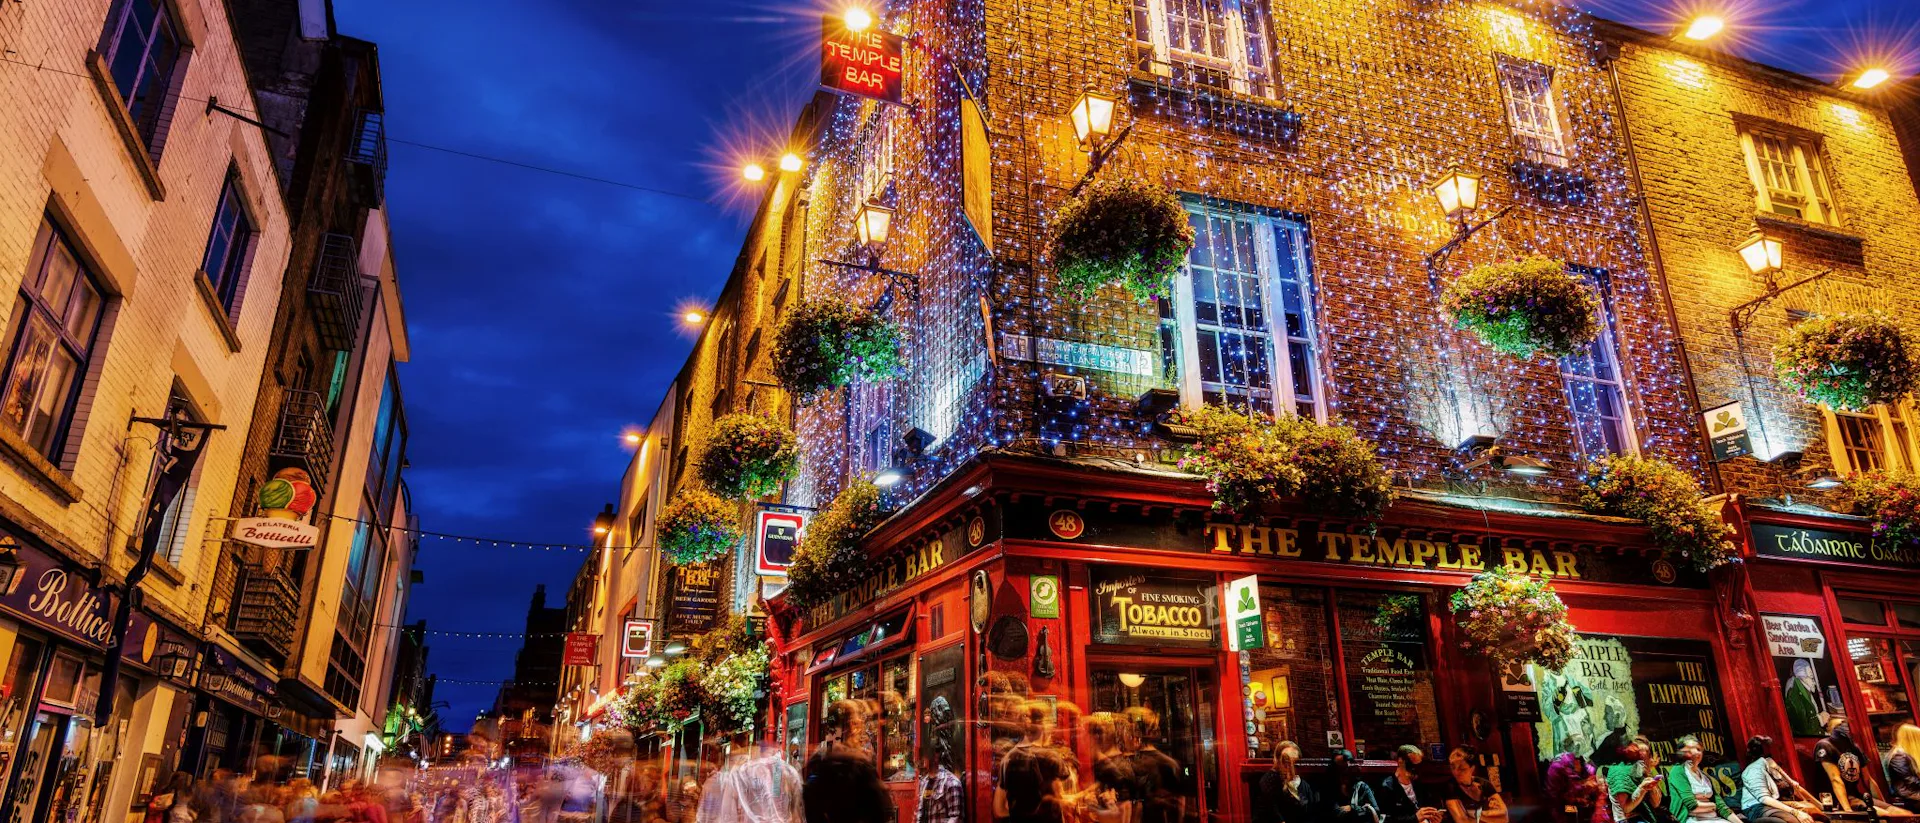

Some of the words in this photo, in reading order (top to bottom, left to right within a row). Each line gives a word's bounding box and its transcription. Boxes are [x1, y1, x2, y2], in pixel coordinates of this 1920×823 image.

[827, 41, 900, 72] TEMPLE
[846, 67, 883, 89] BAR
[1072, 355, 1096, 367] LANE
[256, 522, 299, 532] GELATERIA
[971, 522, 983, 541] 48
[1055, 513, 1077, 531] 48
[242, 527, 312, 544] Botticelli
[1204, 523, 1302, 557] THE
[1317, 531, 1486, 571] TEMPLE
[1501, 547, 1581, 578] BAR
[1656, 564, 1671, 579] 48
[811, 599, 836, 629] THE
[841, 564, 899, 617] TEMPLE
[905, 539, 944, 582] BAR
[1096, 575, 1146, 597] Importers
[1141, 592, 1160, 602] FINE
[1162, 594, 1200, 604] SMOKING
[1110, 596, 1202, 632] TOBACCO
[1130, 627, 1166, 637] Always
[1170, 629, 1180, 637] in
[1182, 629, 1211, 639] Stock
[1764, 619, 1782, 631] Beer
[1783, 620, 1811, 633] Garden
[1767, 631, 1800, 646] Smoking
[1360, 648, 1395, 666] TEMPLE
[1397, 652, 1414, 669] BAR
[1571, 645, 1627, 662] MPLE
[1777, 644, 1796, 656] Area
[1580, 661, 1616, 680] BAR
[1676, 661, 1706, 682] THE
[1648, 683, 1711, 706] EMPEROR
[1698, 709, 1714, 729] OF
